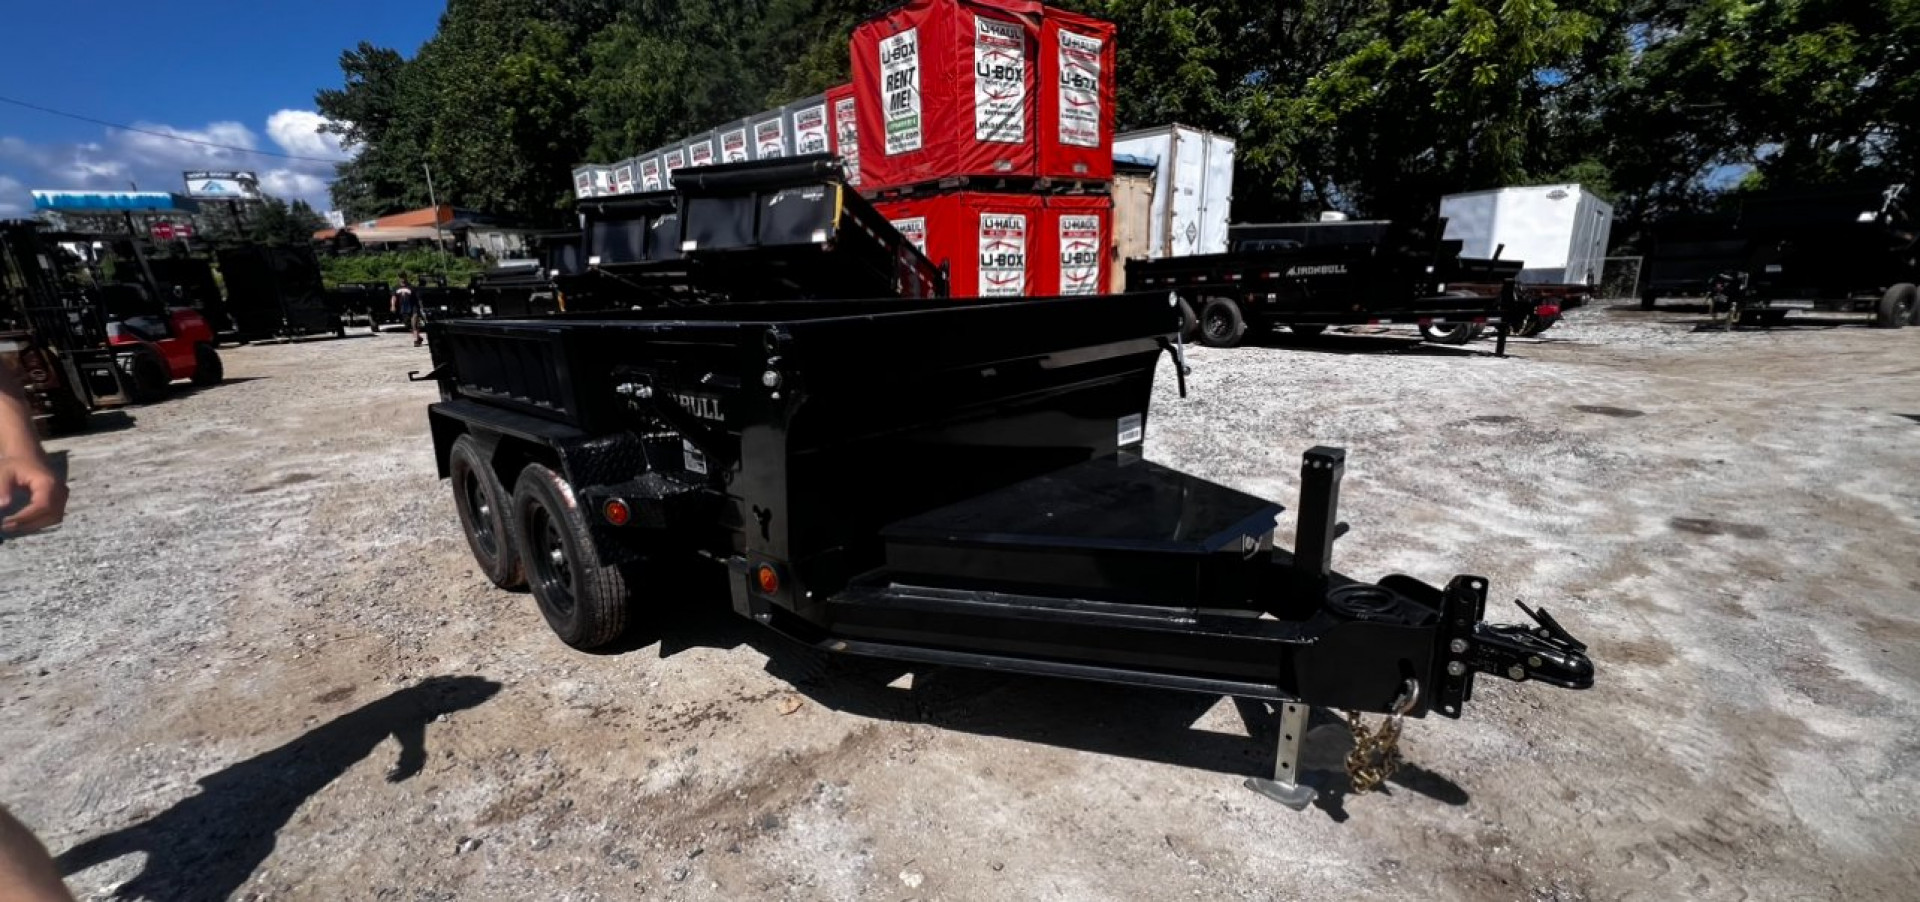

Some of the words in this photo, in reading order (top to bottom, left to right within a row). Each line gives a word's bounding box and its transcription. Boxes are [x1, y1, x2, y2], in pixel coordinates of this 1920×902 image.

[981, 23, 1020, 39] U-HAUL
[1062, 35, 1096, 53] U-HAUL
[882, 42, 915, 65] U-BOX
[886, 66, 915, 93] RENT
[978, 62, 1023, 82] U-BOX
[1061, 71, 1097, 91] U-BOX
[889, 88, 911, 112] ME!
[799, 138, 824, 153] U-BOX
[984, 218, 1022, 230] U-HAUL
[1063, 219, 1096, 230] U-HAUL
[980, 252, 1024, 267] U-BOX
[1062, 251, 1097, 265] U-BOX
[1297, 264, 1348, 276] IRONBULL
